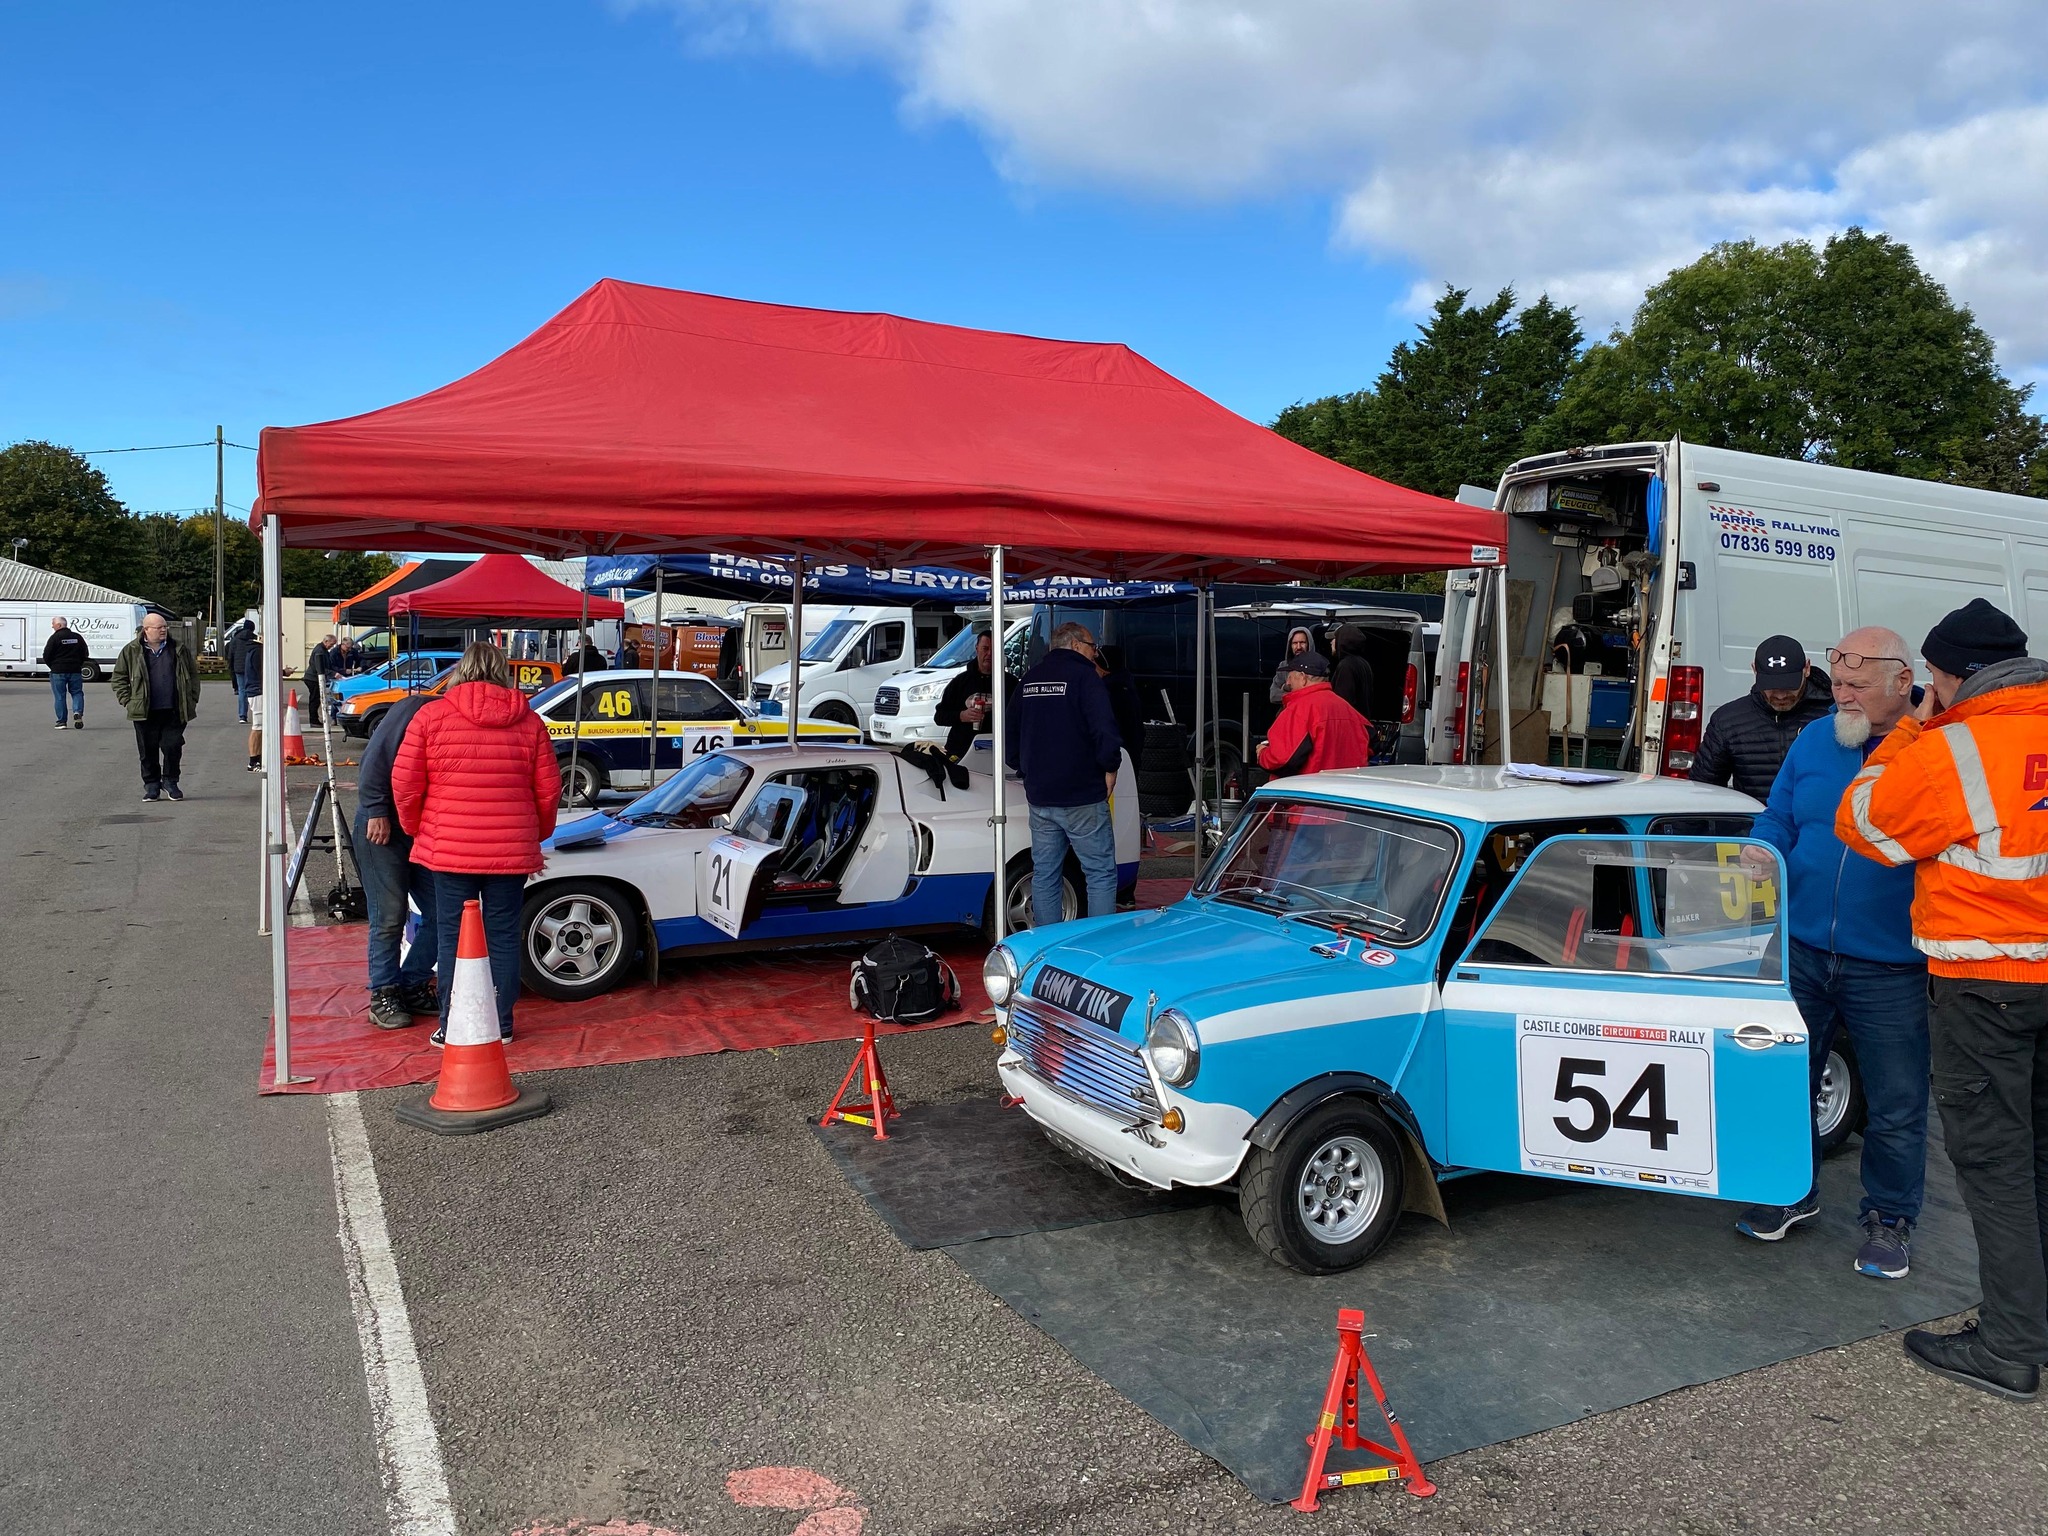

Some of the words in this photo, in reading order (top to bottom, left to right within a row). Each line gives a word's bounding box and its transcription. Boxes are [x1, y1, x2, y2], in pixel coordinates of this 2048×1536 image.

[1560, 499, 1599, 512] PEUGEOT
[1709, 512, 1765, 527] HARRIS
[1771, 520, 1841, 537] RALLYING
[1720, 533, 1770, 553] 07836
[1774, 539, 1803, 556] 599
[1807, 543, 1836, 561] 889
[709, 566, 751, 582] TEL:
[765, 632, 783, 645] 77
[520, 666, 543, 684] 62
[598, 690, 632, 718] 46
[616, 727, 641, 735] SUPPLIES
[692, 735, 725, 755] 46
[711, 853, 732, 911] 21
[1715, 842, 1777, 921] 54
[1038, 969, 1078, 1007] HMM
[1075, 982, 1120, 1024] 711K
[1523, 1019, 1561, 1033] CASTLE
[1563, 1021, 1602, 1036] COMBE
[1603, 1025, 1637, 1038] CIRCUIT
[1639, 1029, 1667, 1040] STAGE
[1669, 1030, 1706, 1044] RALLY
[1552, 1056, 1680, 1151] 54
